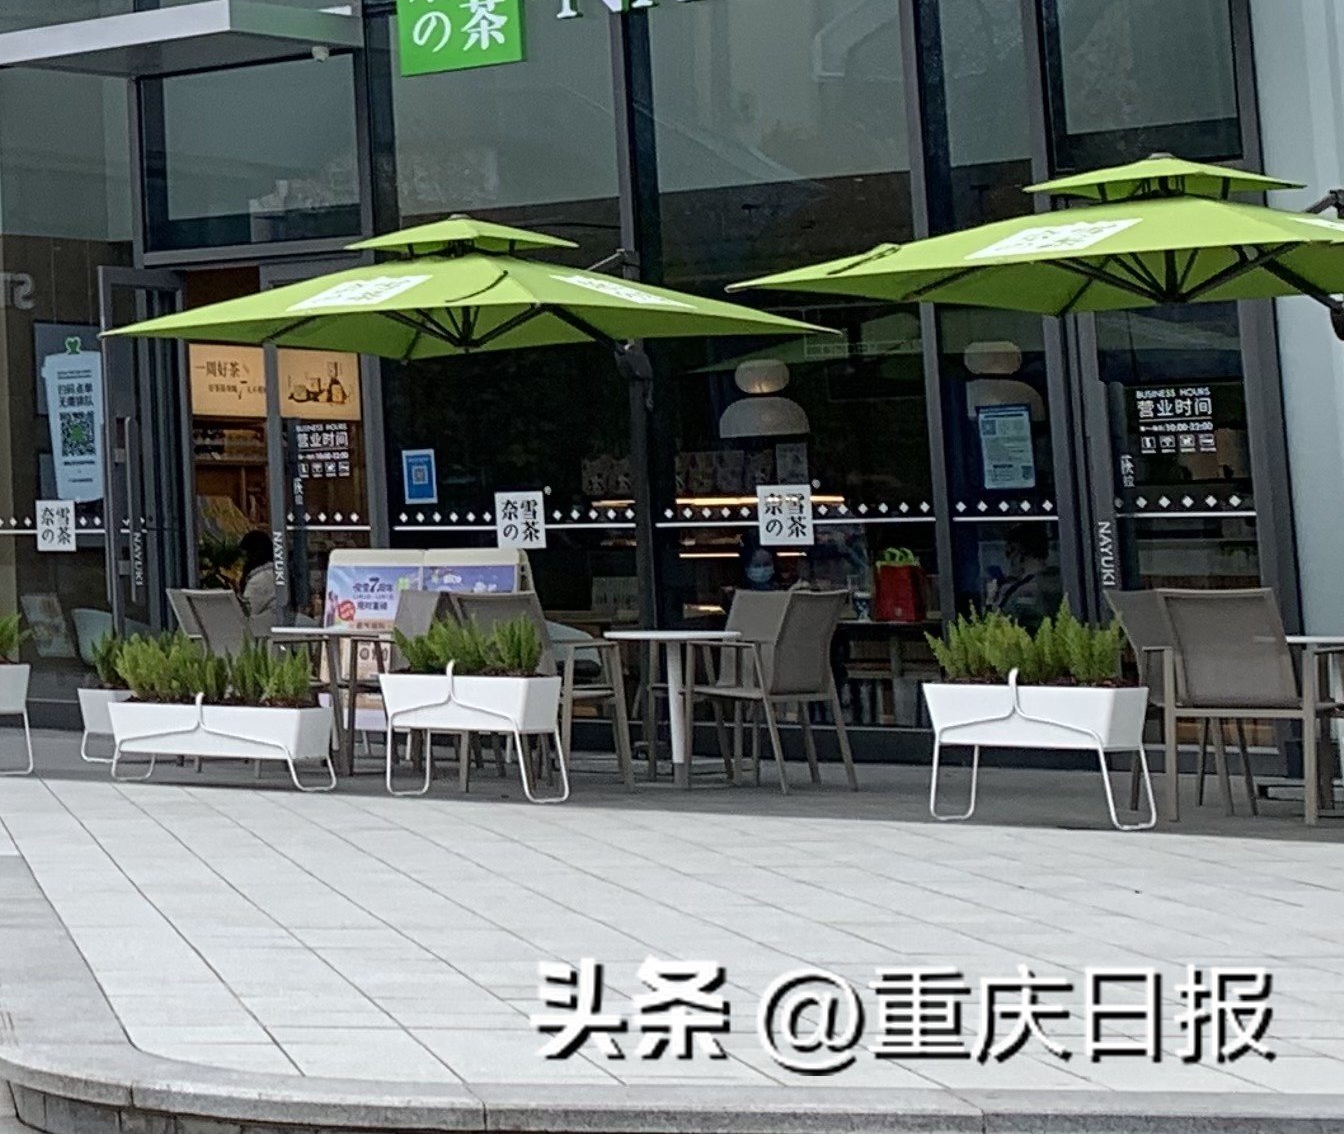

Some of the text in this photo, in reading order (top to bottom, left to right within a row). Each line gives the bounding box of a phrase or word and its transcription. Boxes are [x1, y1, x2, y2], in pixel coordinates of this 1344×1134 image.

[1136, 386, 1211, 399] BUSINESS HOURS
[1136, 397, 1213, 418] 营业时间
[297, 431, 349, 448] 营业时间
[501, 498, 539, 519] 奈雪
[503, 520, 540, 543] の茶
[766, 516, 807, 538] の茶
[133, 531, 144, 586] NAYUKI
[272, 530, 285, 586] NAYUKI
[1097, 521, 1116, 586] NAYUKI
